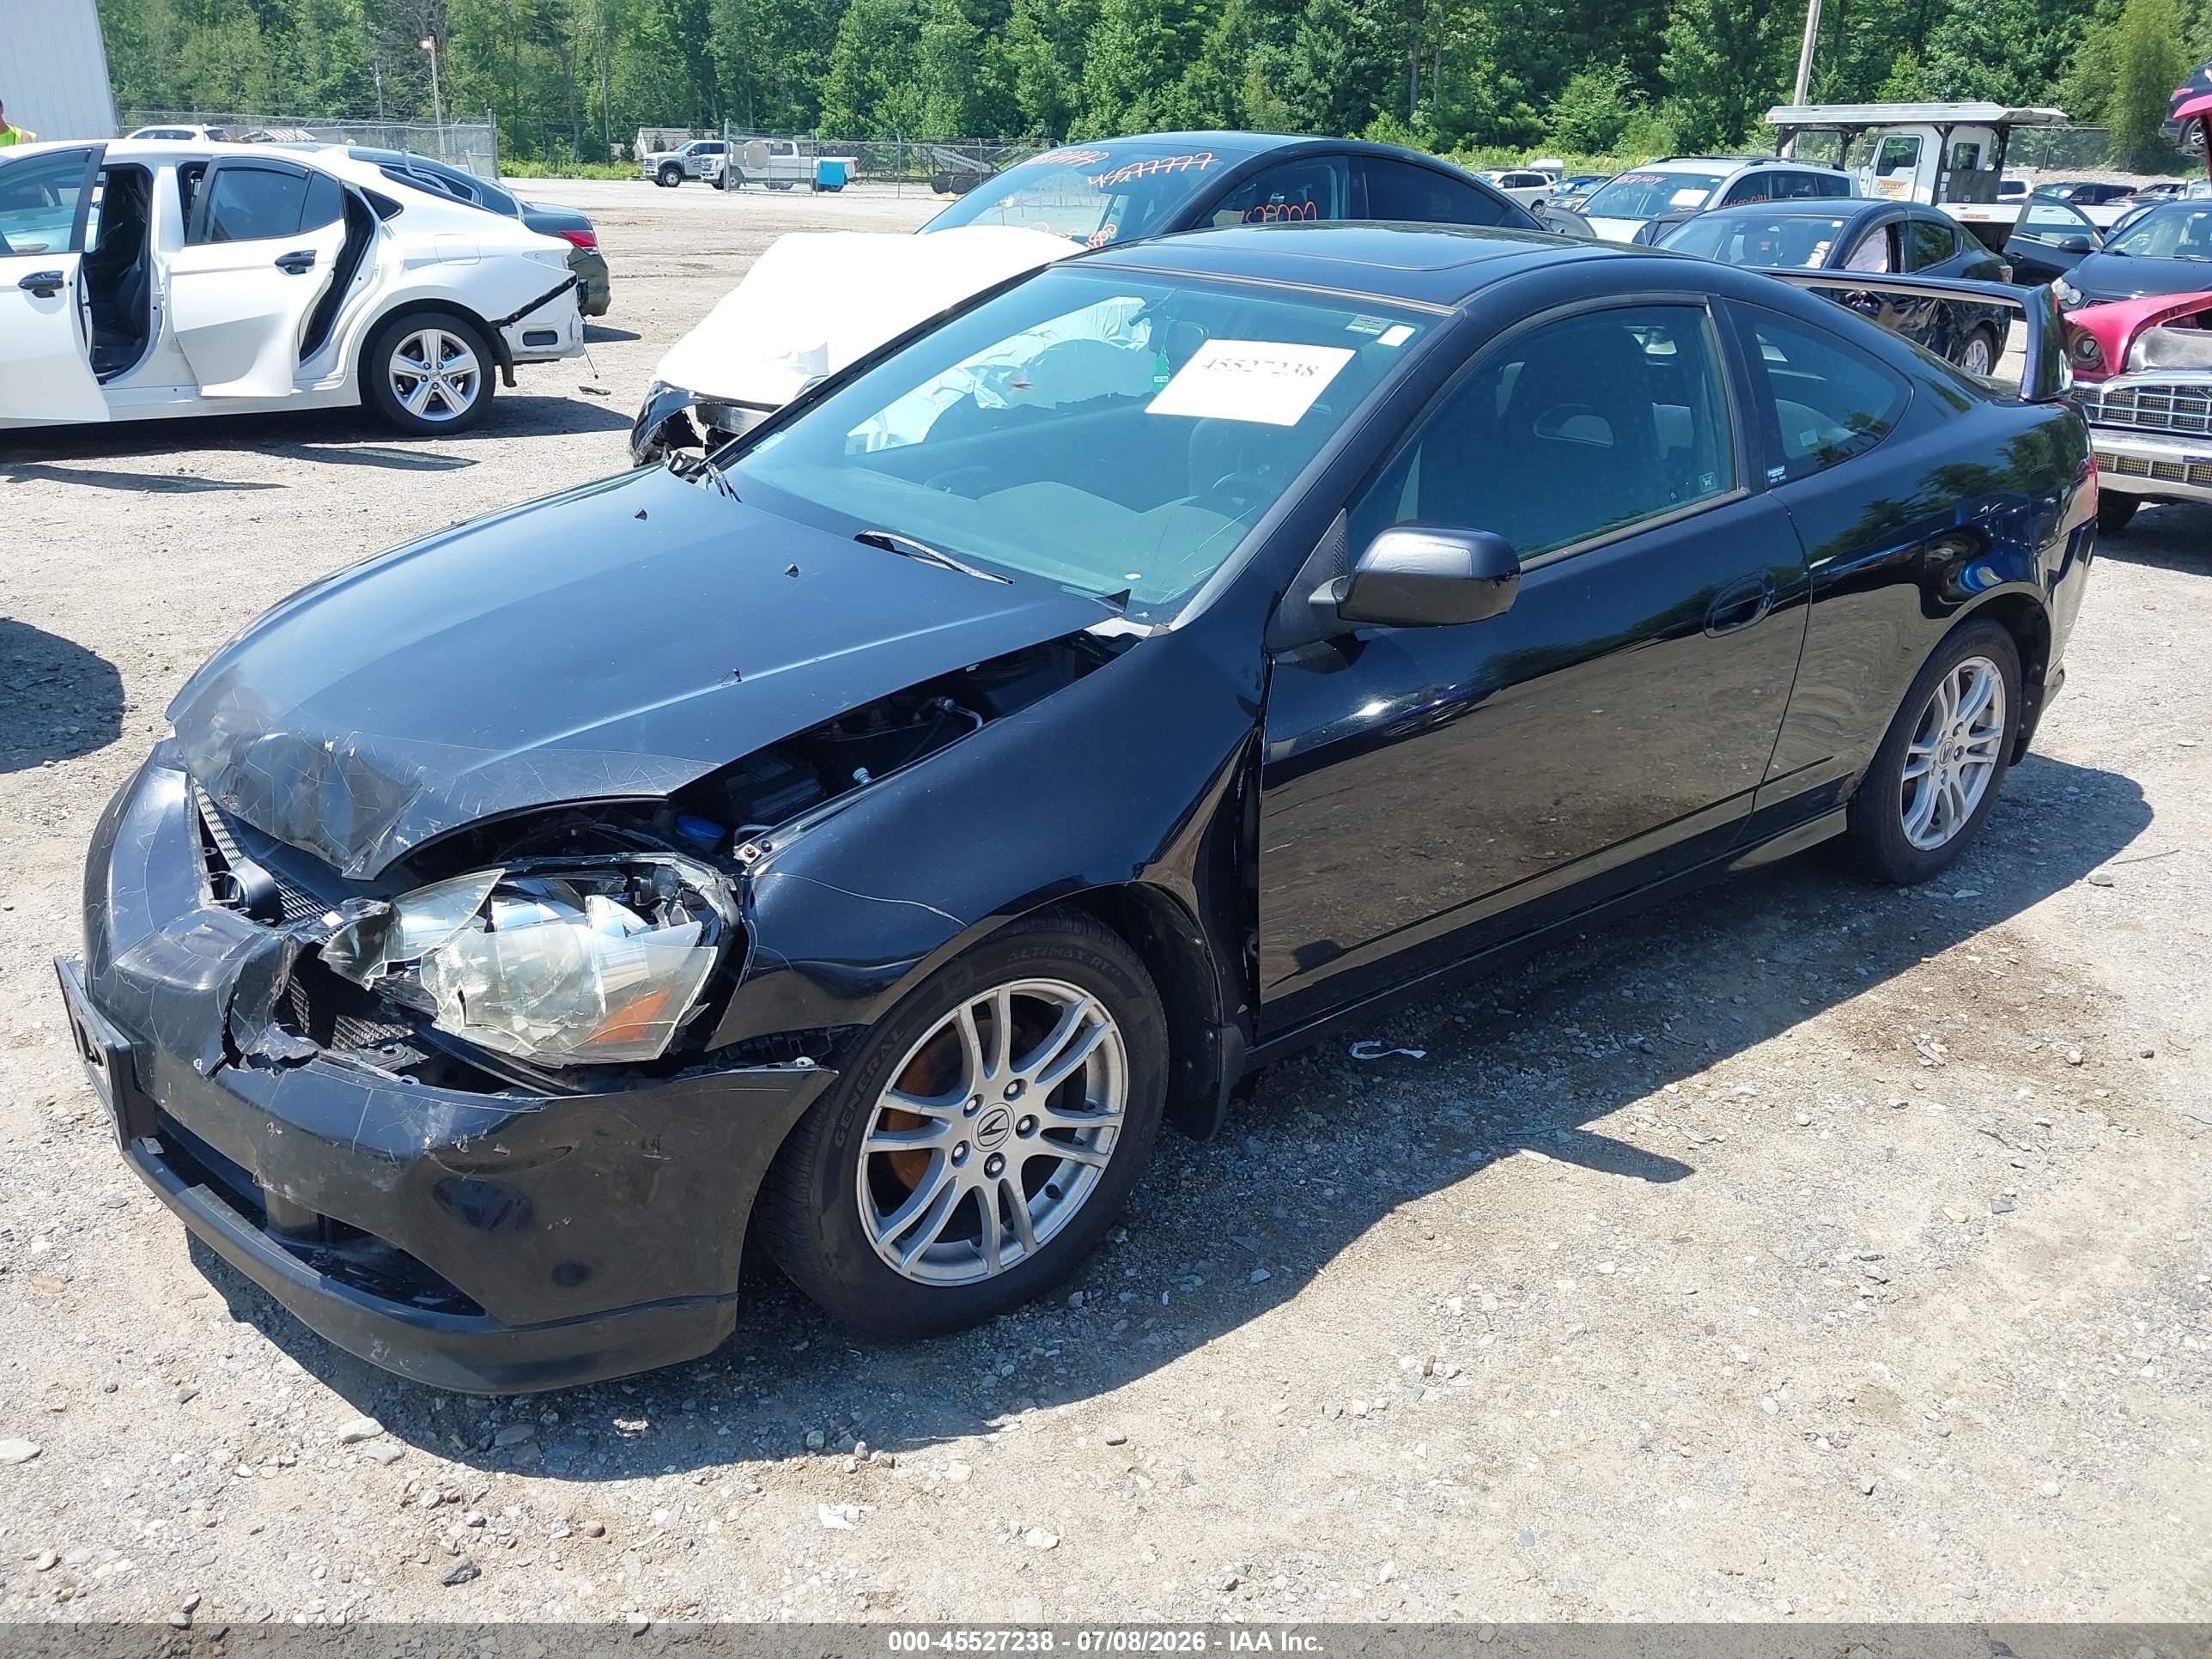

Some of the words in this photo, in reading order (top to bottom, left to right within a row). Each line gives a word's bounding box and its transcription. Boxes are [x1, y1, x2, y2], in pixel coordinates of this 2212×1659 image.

[1202, 357, 1319, 378] 45527238
[1007, 946, 1088, 962] ALTIMAX
[835, 1029, 906, 1148] GENERAL
